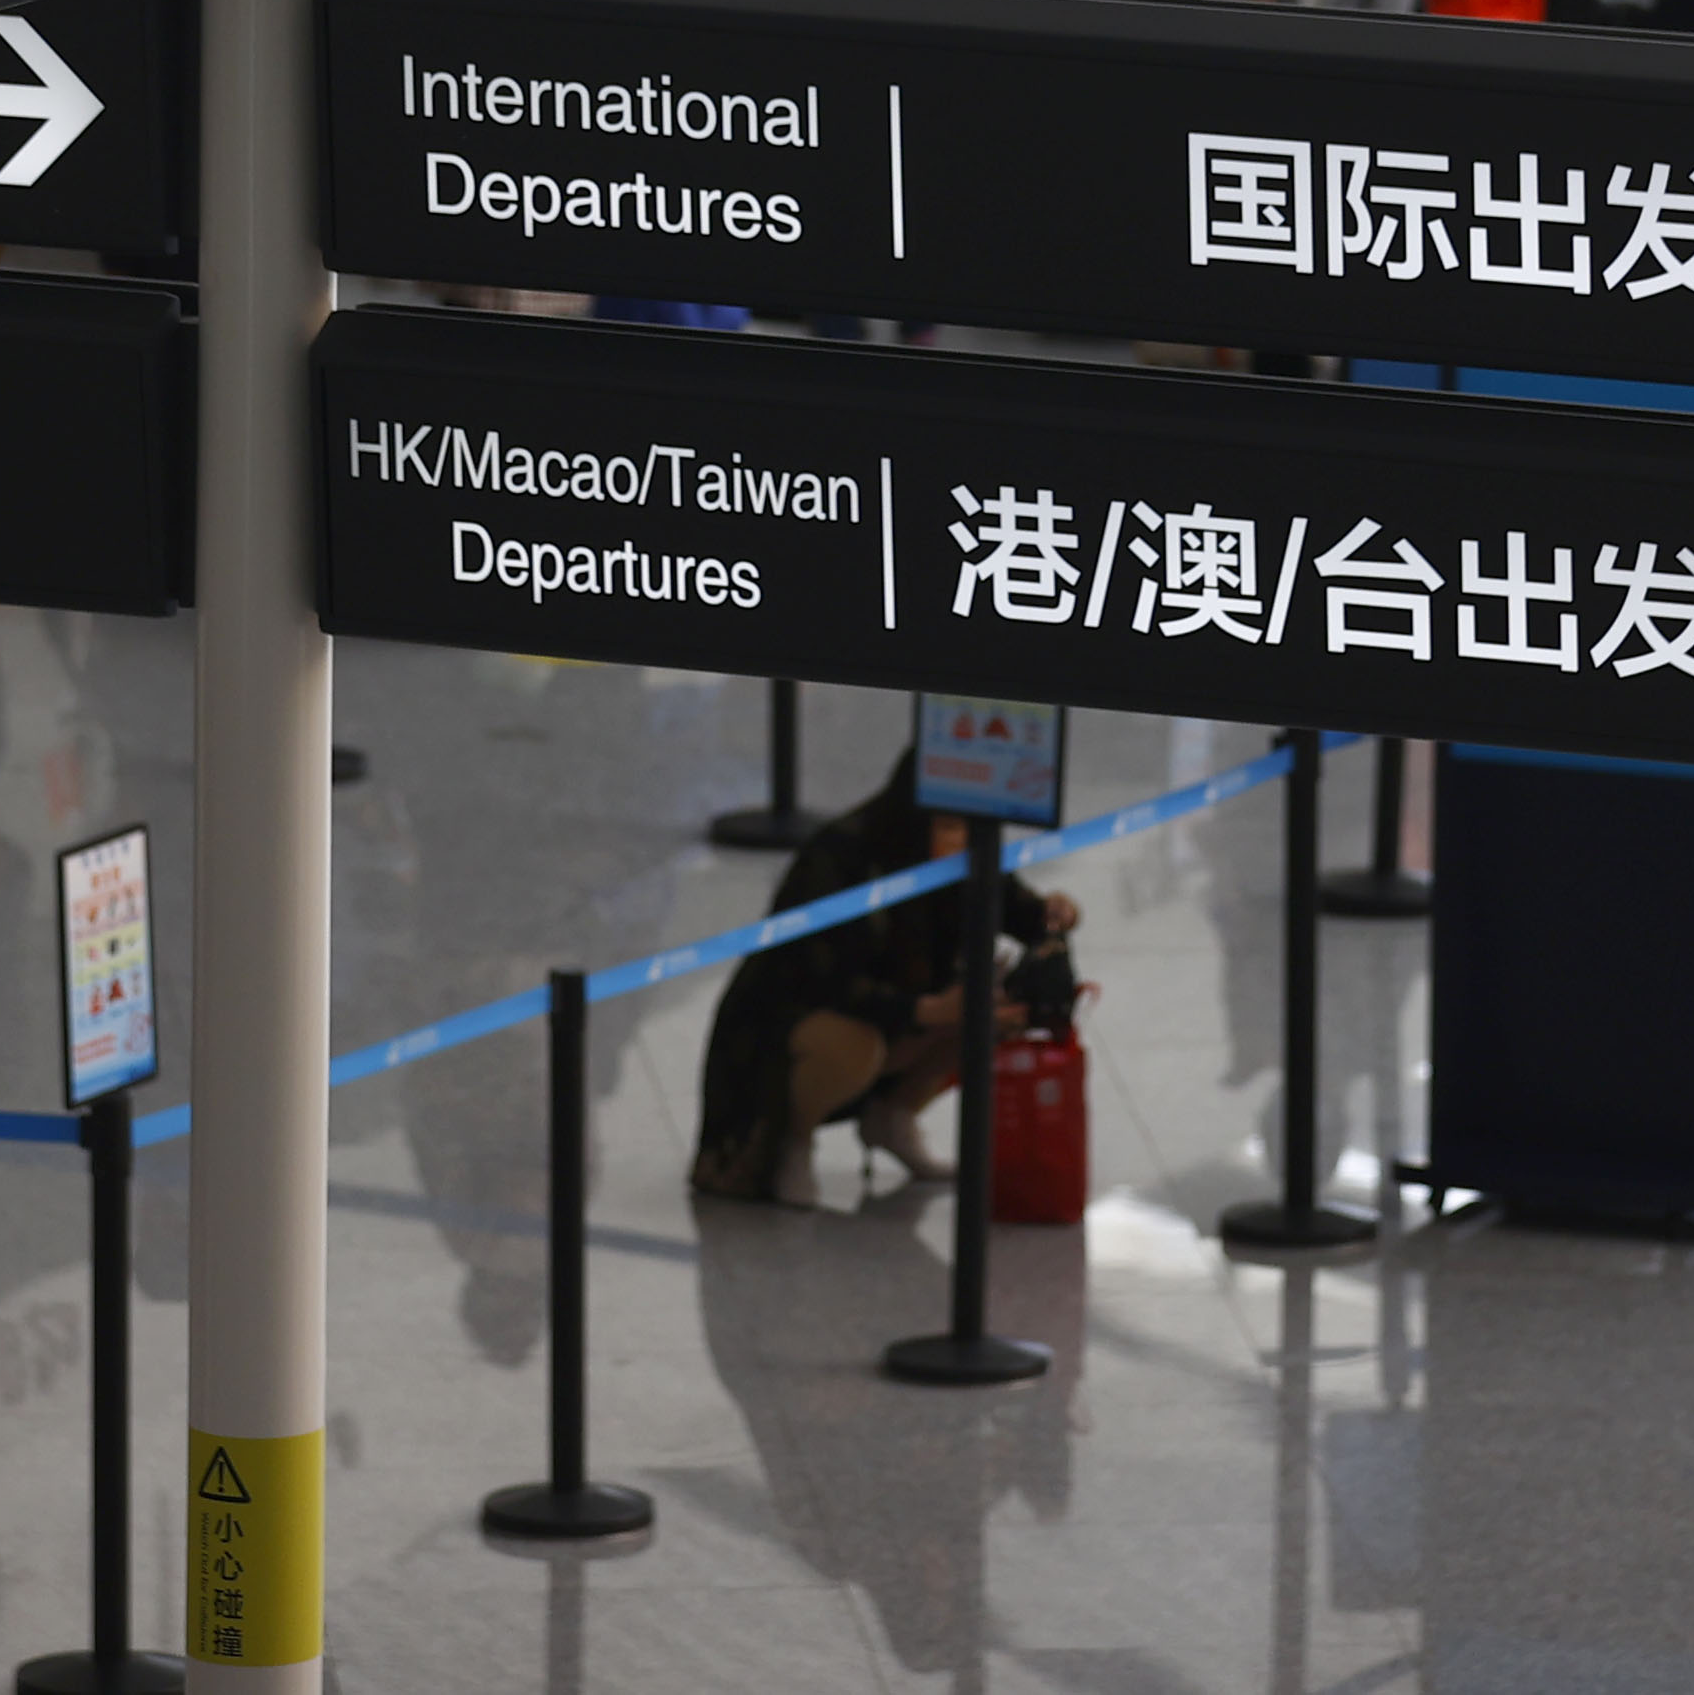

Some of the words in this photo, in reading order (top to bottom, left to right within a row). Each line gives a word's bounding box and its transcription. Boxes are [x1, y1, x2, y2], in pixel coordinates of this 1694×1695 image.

[402, 54, 821, 149] International
[425, 151, 803, 244] Departures
[349, 418, 862, 525] HK/Macao/Taiwan
[451, 520, 763, 609] Departures
[213, 1511, 244, 1658] 小心碰撞
